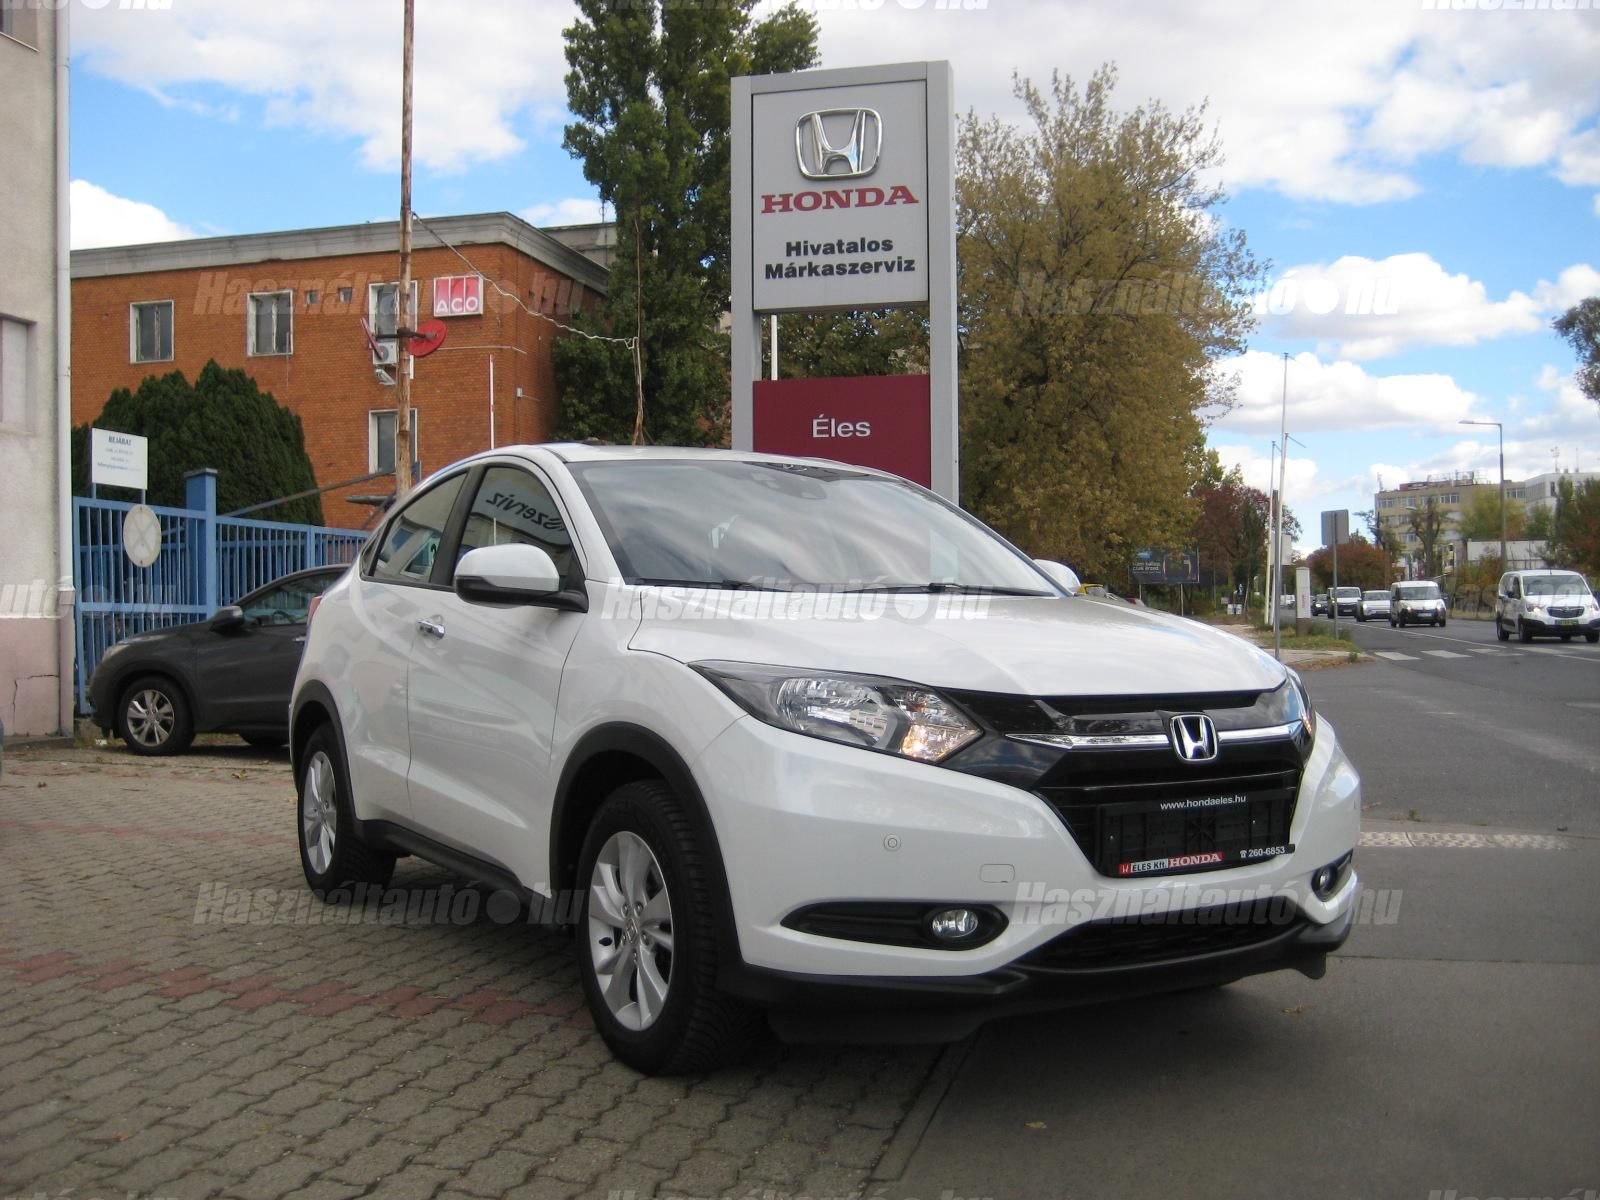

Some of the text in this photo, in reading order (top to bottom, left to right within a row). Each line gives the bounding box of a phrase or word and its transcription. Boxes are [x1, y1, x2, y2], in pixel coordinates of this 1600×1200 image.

[761, 185, 919, 214] HONDA
[786, 237, 893, 257] Hivatalos
[765, 256, 915, 279] Márkaszerviz
[436, 296, 478, 314] ACO
[812, 413, 871, 438] Éles
[1159, 794, 1247, 811] www.hondaeles.hu
[1168, 853, 1222, 868] HONDA
[1248, 846, 1286, 858] 260-6853
